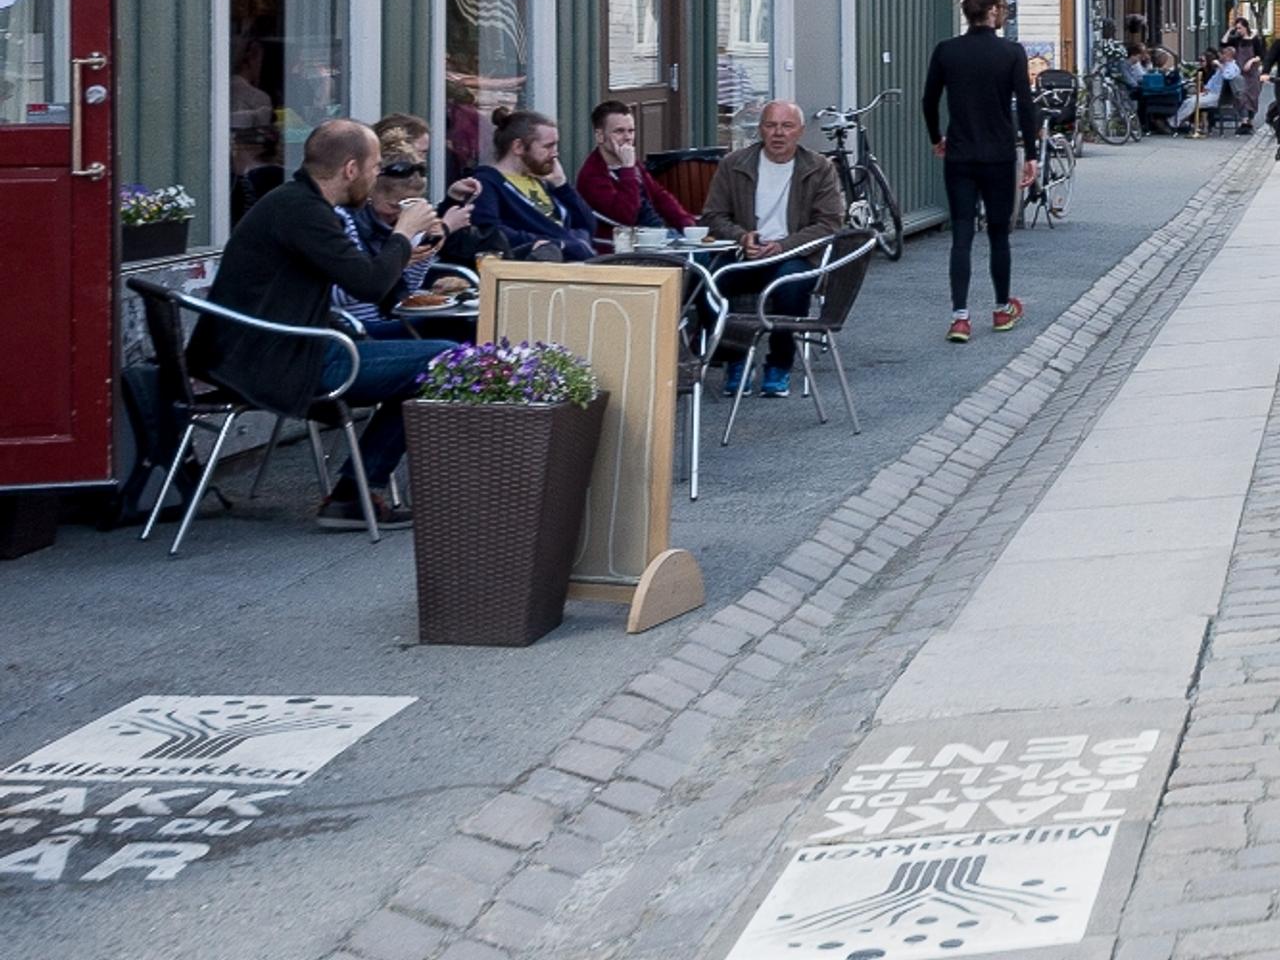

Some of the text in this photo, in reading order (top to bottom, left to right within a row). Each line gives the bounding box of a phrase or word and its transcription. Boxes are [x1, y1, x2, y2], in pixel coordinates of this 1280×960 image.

[856, 729, 1161, 772] PENT
[827, 775, 1140, 811] FOR AT DU
[842, 757, 1149, 790] SYKLER
[154, 818, 254, 836] DU
[808, 791, 1126, 839] TAKK
[0, 835, 211, 880] ÅR
